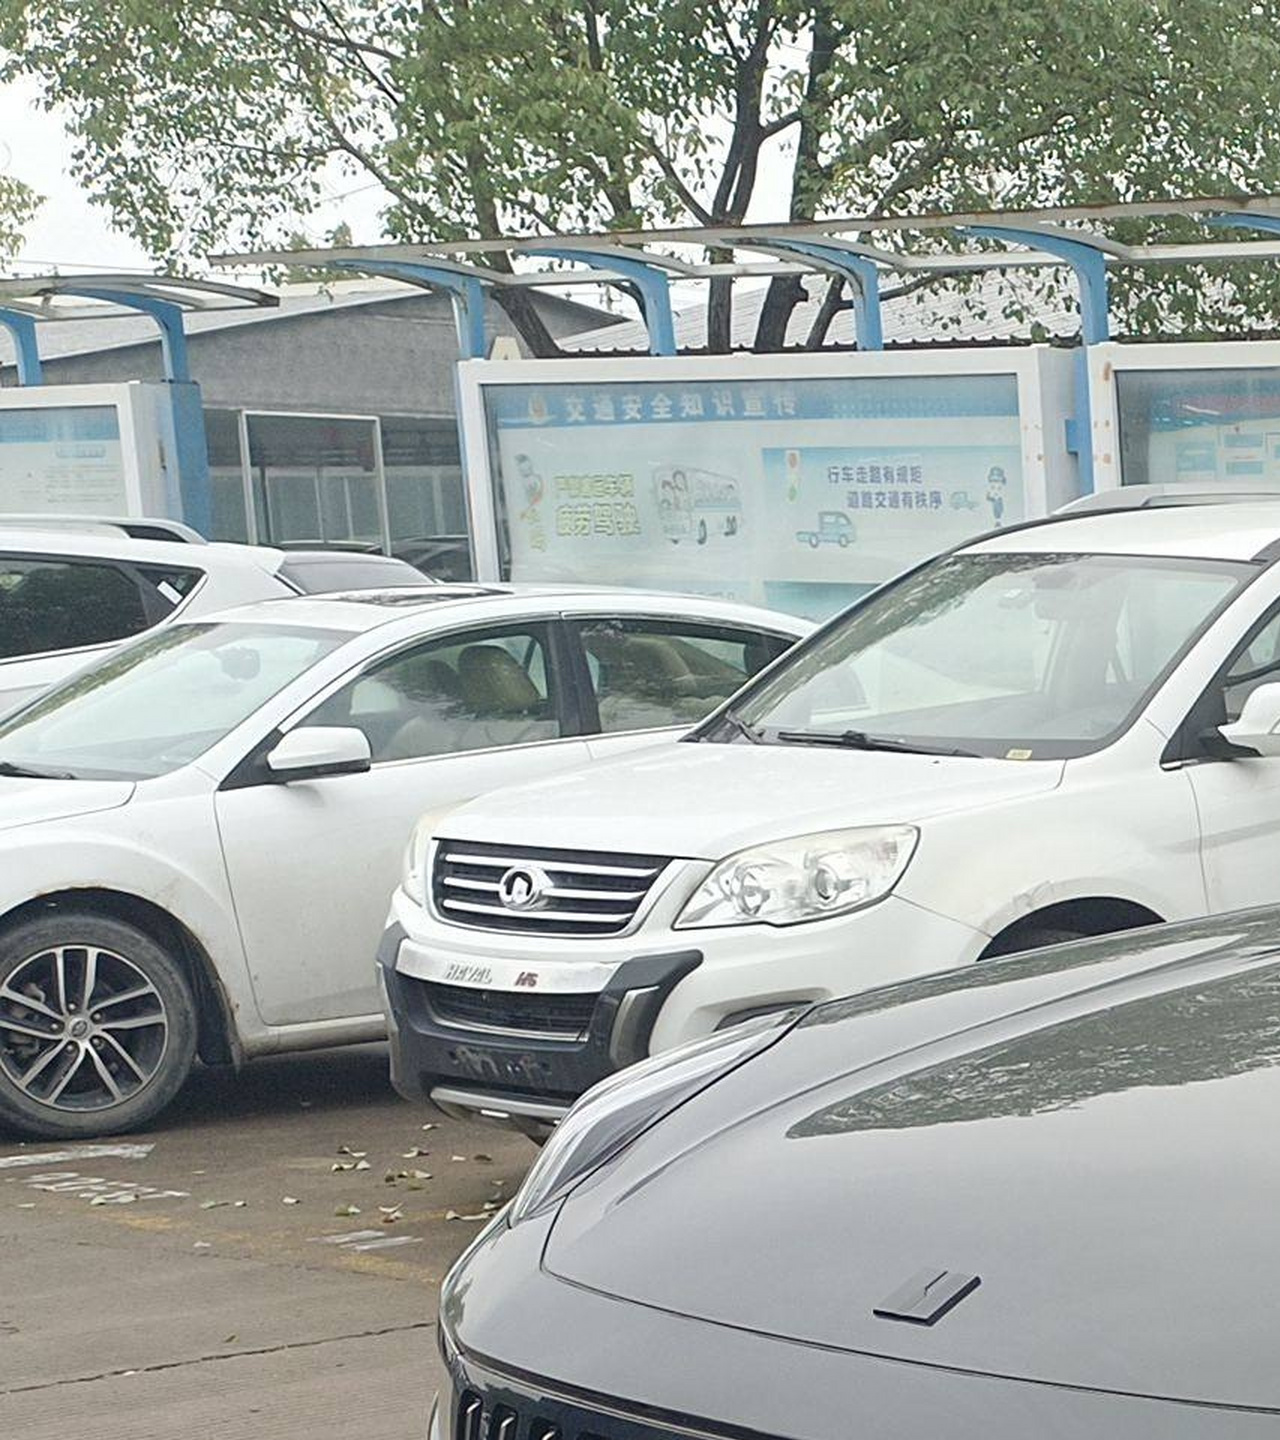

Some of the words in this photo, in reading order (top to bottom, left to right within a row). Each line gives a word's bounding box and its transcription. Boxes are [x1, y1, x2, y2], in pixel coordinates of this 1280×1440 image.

[565, 388, 797, 421] 交通安全知识宣传
[827, 465, 923, 485] 行车走路有规矩
[846, 490, 943, 509] 道路交通有秩序
